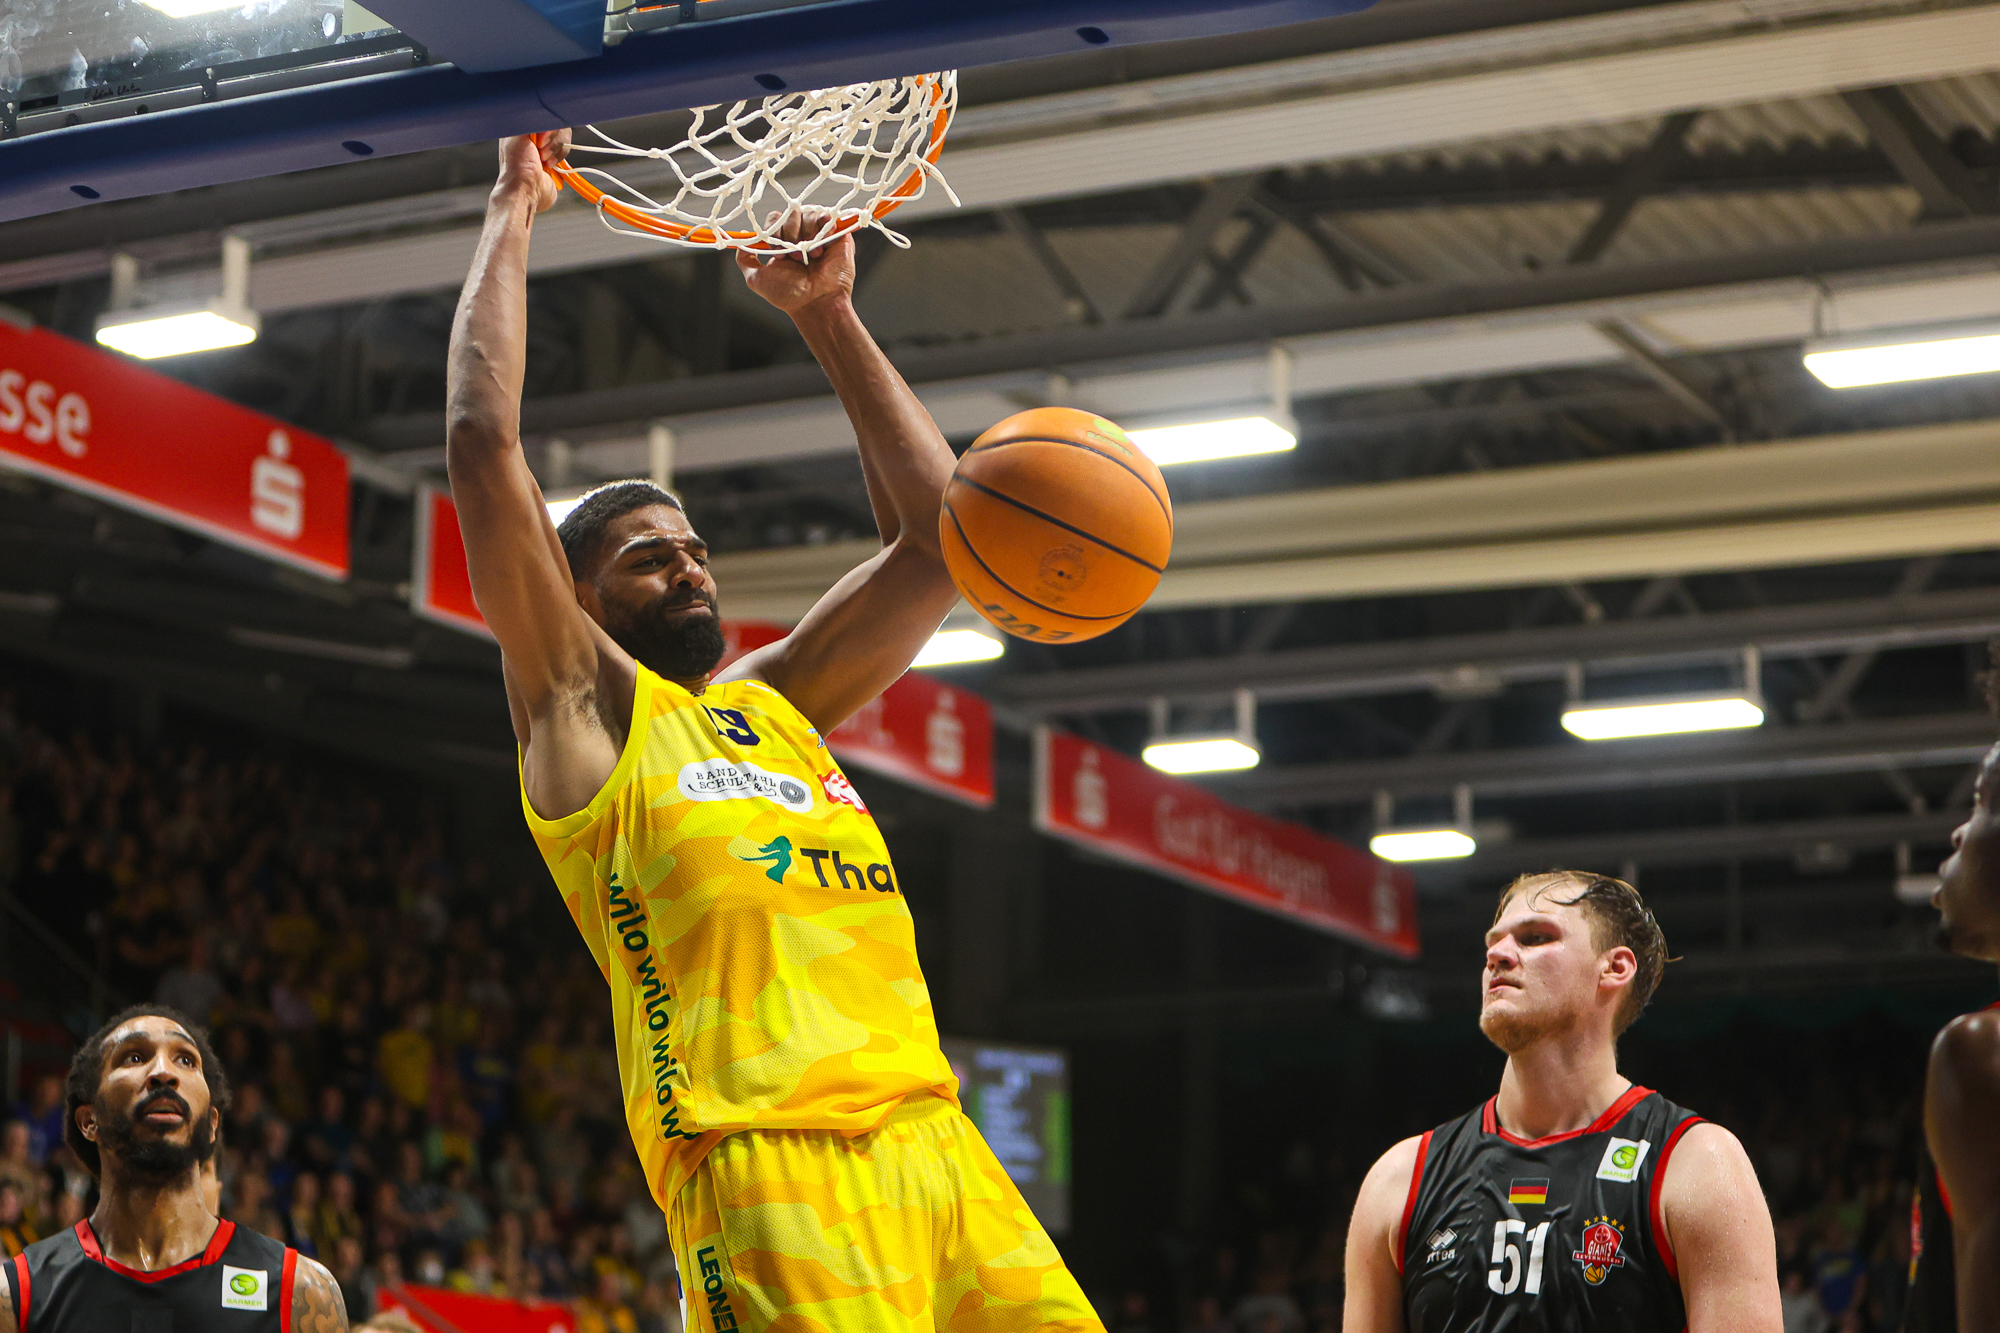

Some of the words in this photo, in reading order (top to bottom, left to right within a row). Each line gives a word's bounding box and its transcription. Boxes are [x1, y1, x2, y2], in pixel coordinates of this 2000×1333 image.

[800, 847, 902, 895] Tha
[609, 872, 649, 952] wilo
[637, 953, 671, 1031] wilo
[653, 1033, 677, 1105] wilo
[1601, 1169, 1634, 1179] BARME
[1488, 1218, 1551, 1295] 51
[1587, 1240, 1613, 1258] GIANTS
[226, 1298, 263, 1307] BARMER
[697, 1245, 740, 1333] LEONE
